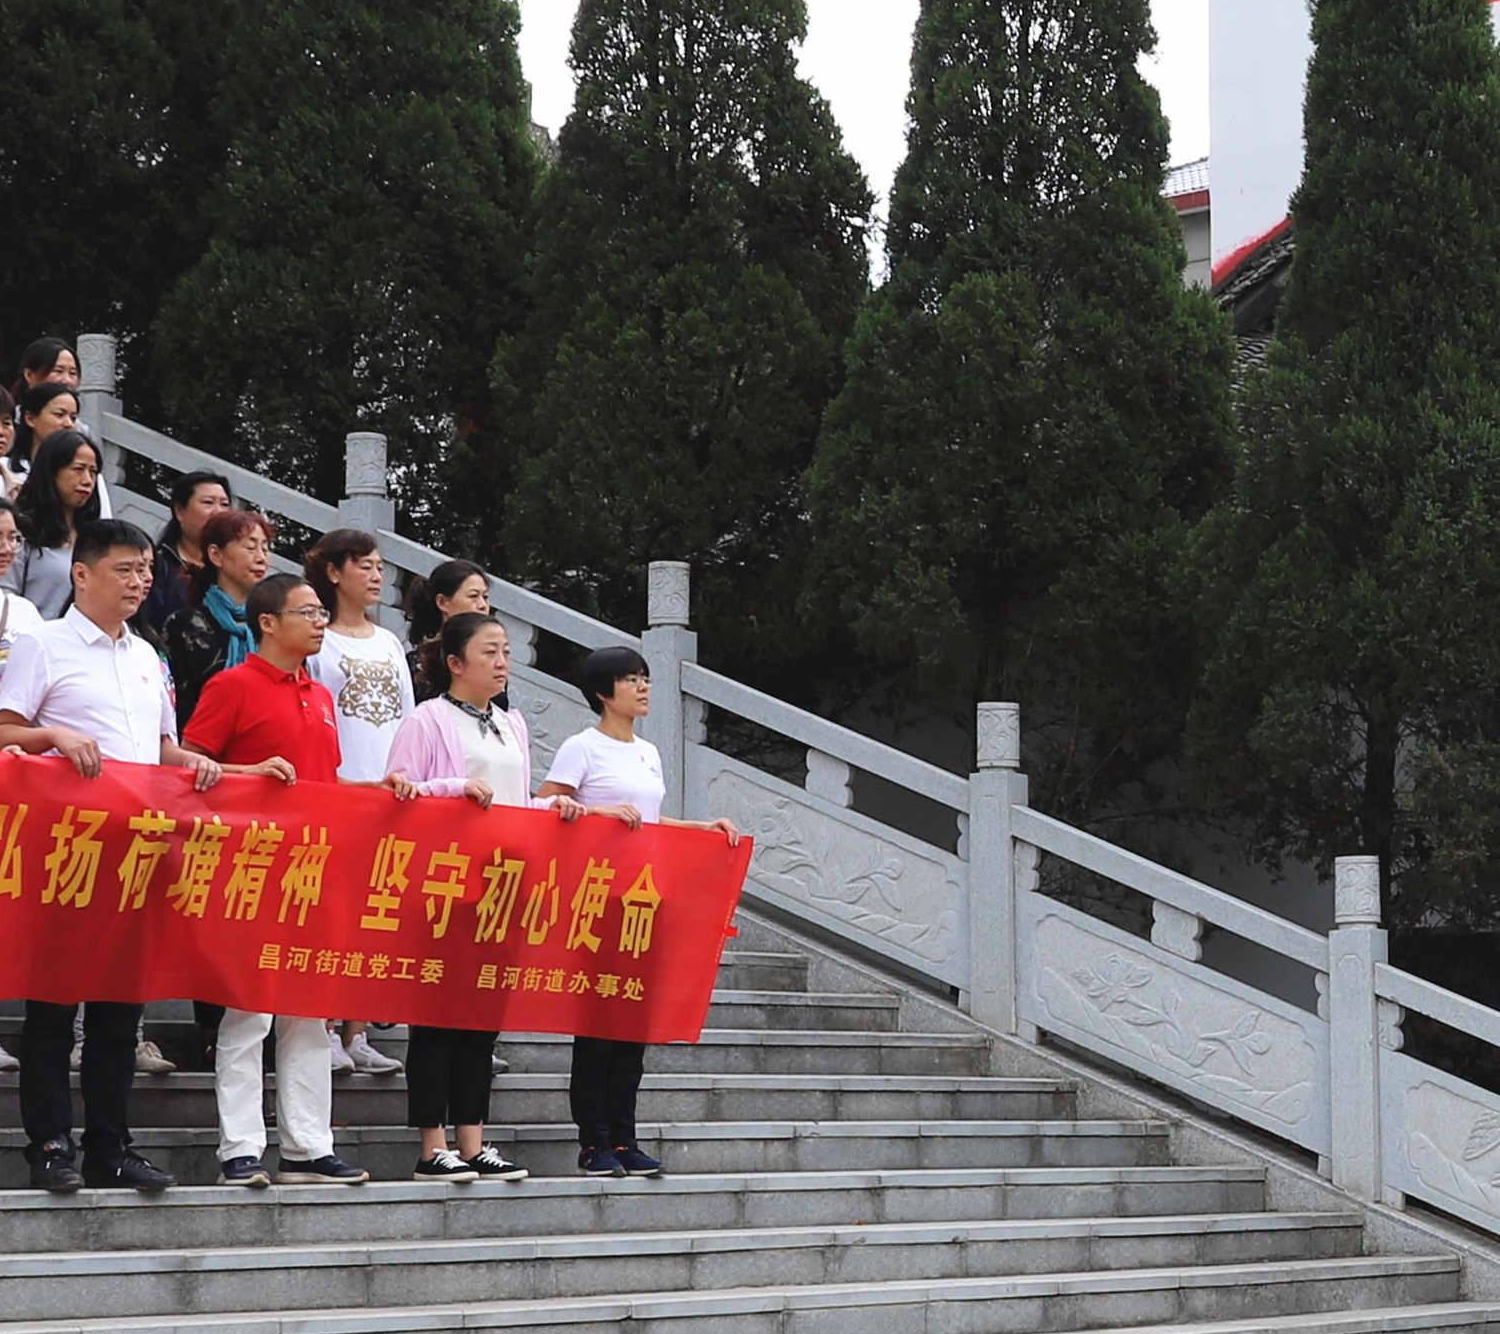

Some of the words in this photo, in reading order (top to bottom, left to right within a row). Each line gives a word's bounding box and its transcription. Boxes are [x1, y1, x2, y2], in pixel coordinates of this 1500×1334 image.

[360, 833, 664, 959] 坚守初心使命
[258, 943, 445, 985] 昌河街道党工委
[476, 963, 645, 1001] 昌河街道办事处
